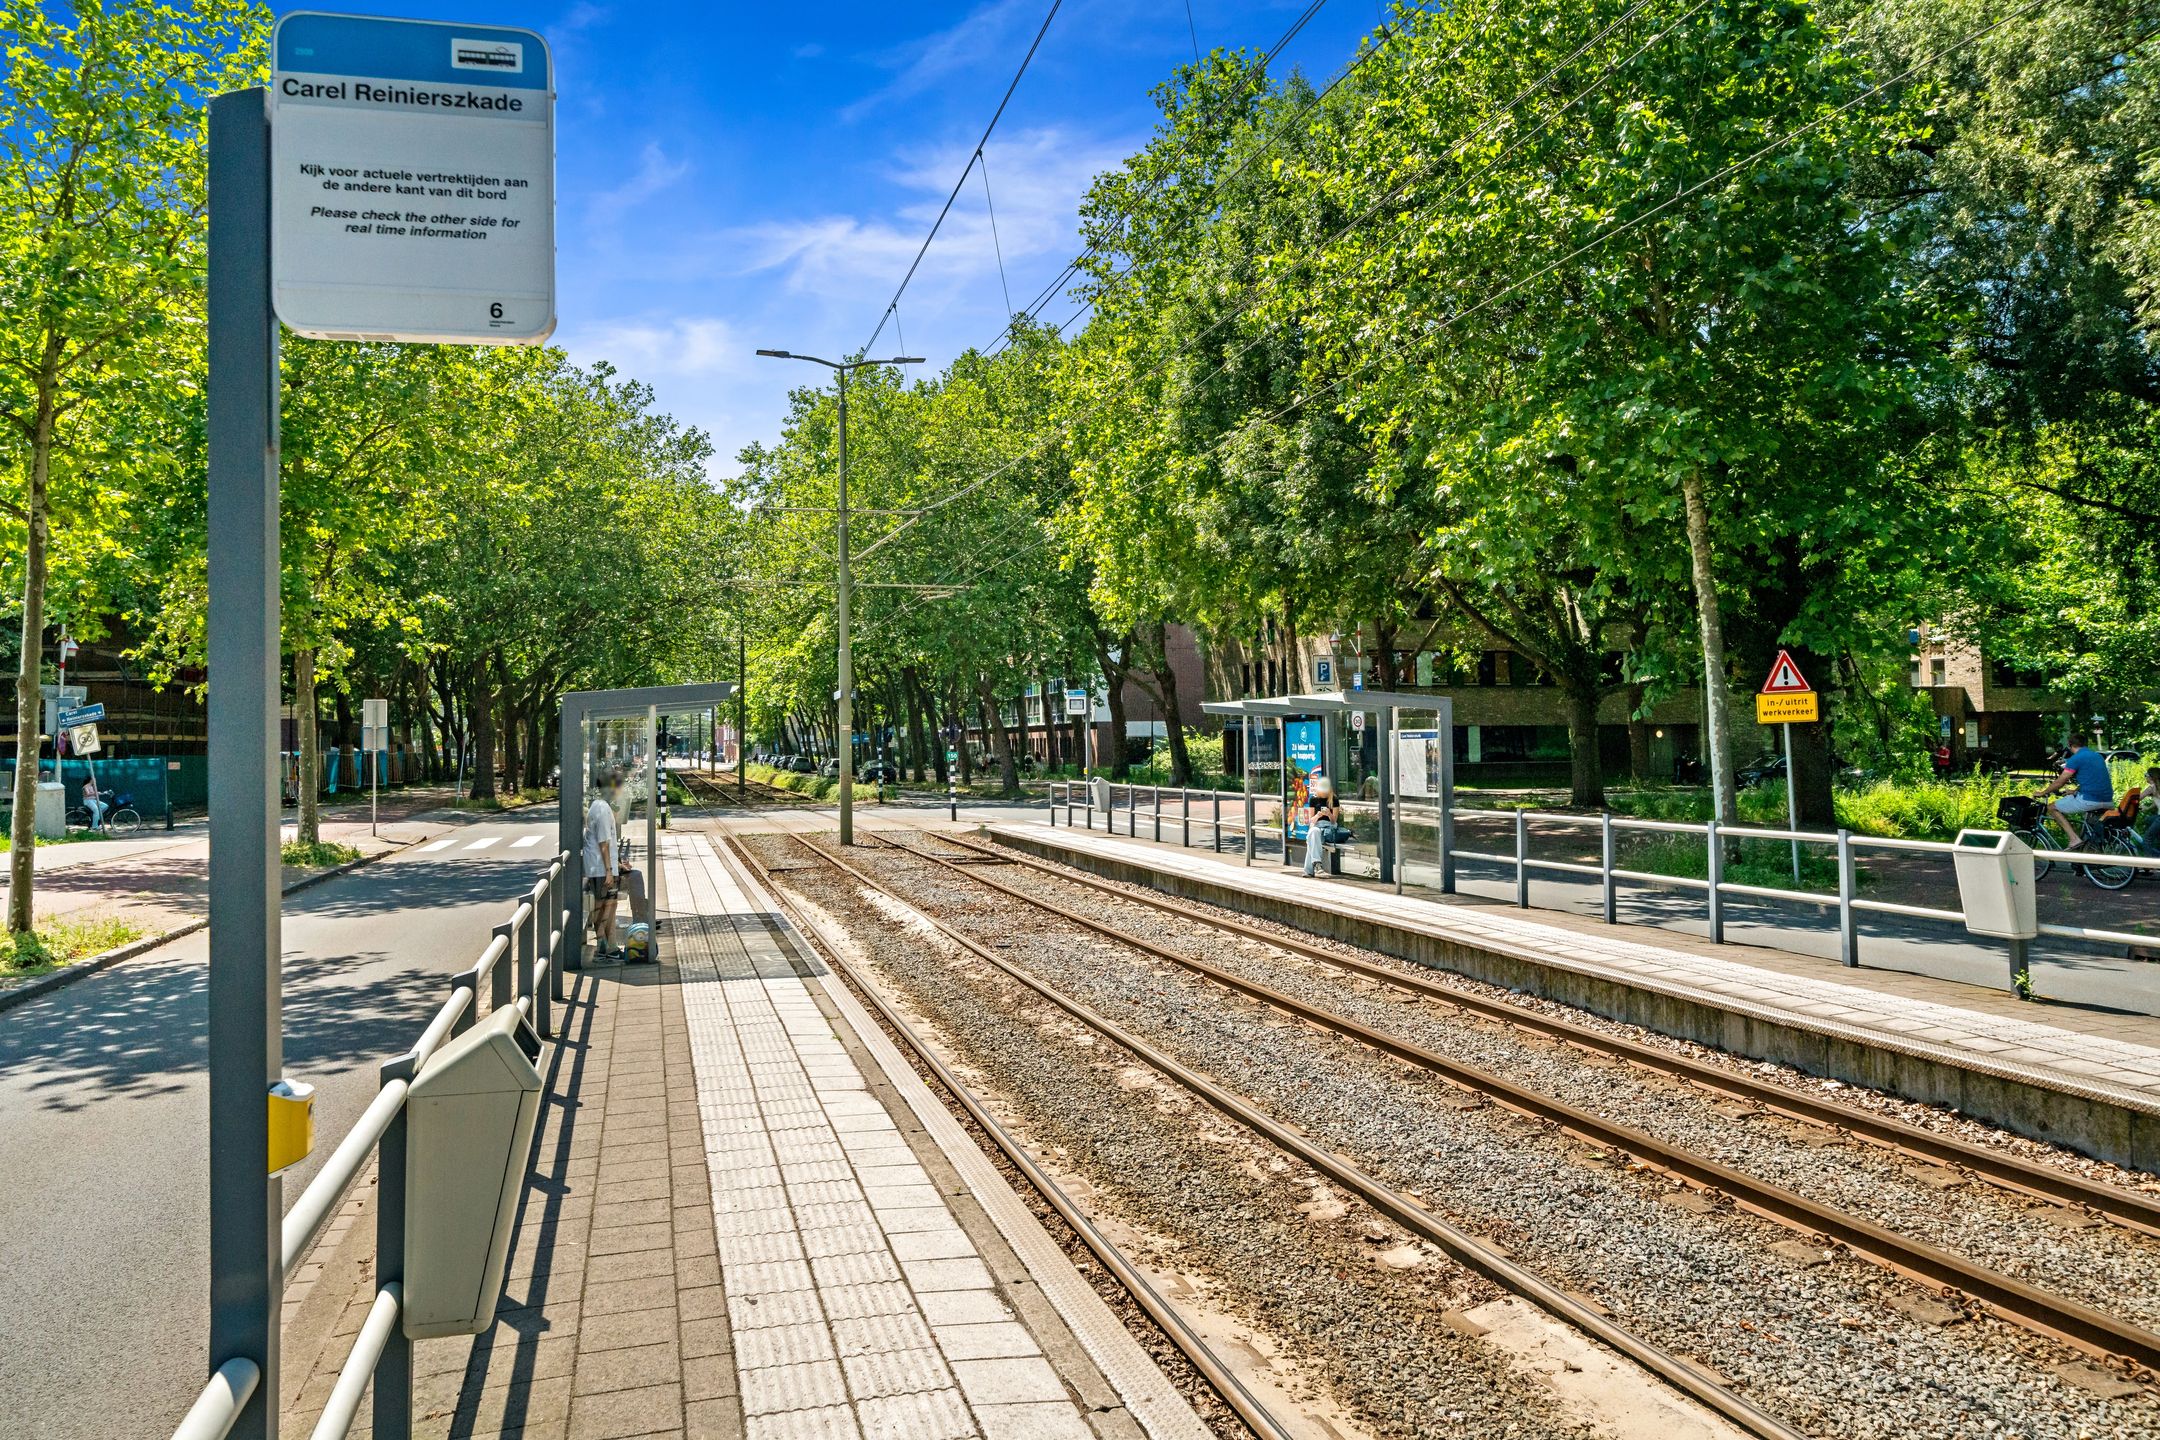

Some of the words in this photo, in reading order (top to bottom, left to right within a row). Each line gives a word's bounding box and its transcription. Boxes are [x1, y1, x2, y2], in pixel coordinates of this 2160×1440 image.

[282, 78, 346, 100] Carel
[355, 83, 523, 112] Reinierszkade
[300, 163, 325, 177] Kijk
[329, 168, 359, 178] voor
[363, 169, 413, 181] actuele
[416, 173, 500, 187] vertrektijden
[504, 178, 528, 188] aan
[322, 179, 340, 190] de
[344, 182, 391, 193] andere
[395, 184, 425, 195] kant
[429, 188, 452, 197] van
[456, 187, 474, 199] dit
[477, 189, 507, 200] bord
[310, 206, 358, 219] Please
[361, 210, 401, 221] check
[405, 212, 427, 223] the
[430, 213, 467, 225] other
[470, 215, 498, 227] side
[501, 217, 521, 228] for
[345, 223, 373, 234] real
[376, 224, 406, 236] time
[409, 225, 487, 240] information
[490, 302, 503, 319] 6
[1785, 697, 1809, 706] uitrit
[1762, 708, 1814, 717] werkverkeer
